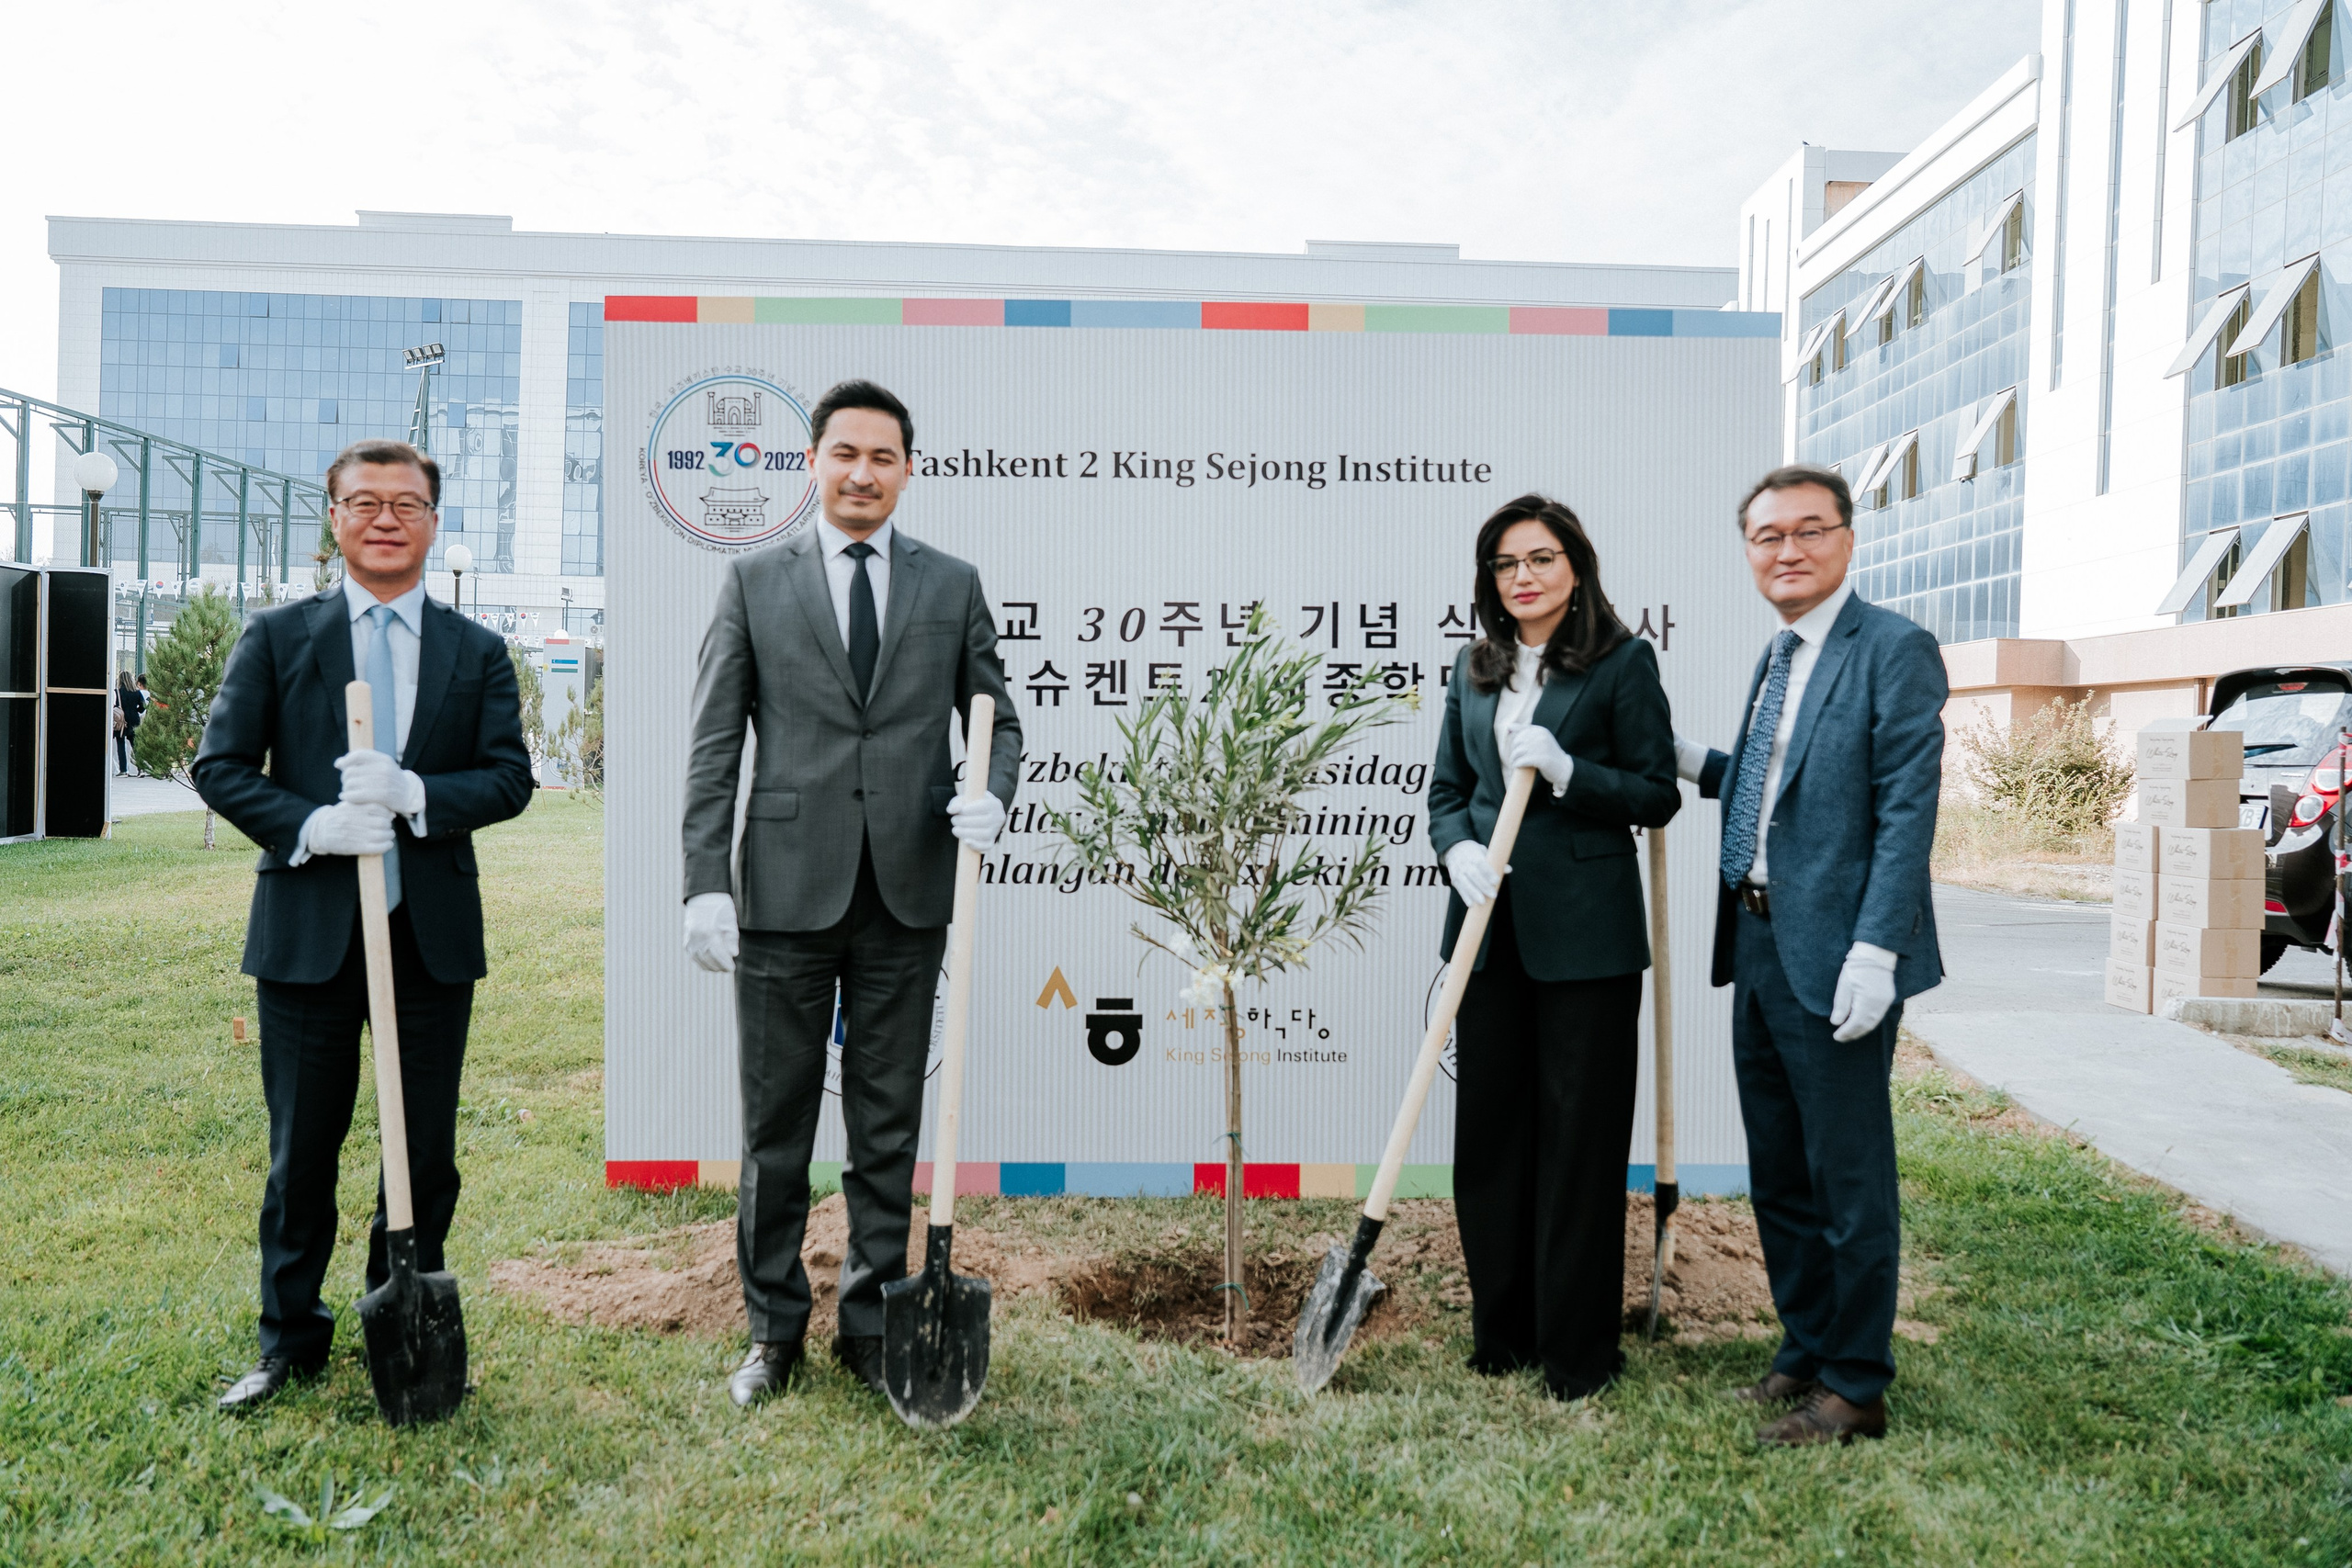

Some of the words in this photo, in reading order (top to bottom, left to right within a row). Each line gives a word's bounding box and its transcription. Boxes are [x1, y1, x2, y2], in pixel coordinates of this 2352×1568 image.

[639, 446, 649, 484] KOREYA
[667, 450, 706, 470] 1992
[707, 441, 762, 478] 30
[764, 451, 806, 471] 2022
[1079, 450, 1099, 479] 2
[1113, 451, 1196, 488] King
[1205, 452, 1328, 490] Sejong
[1338, 454, 1493, 483] Institute
[998, 602, 1042, 641] 교
[1299, 601, 1397, 649] 기념
[1165, 1048, 1205, 1066] King
[1210, 1048, 1271, 1066] Song
[1277, 1049, 1348, 1064] Institute
